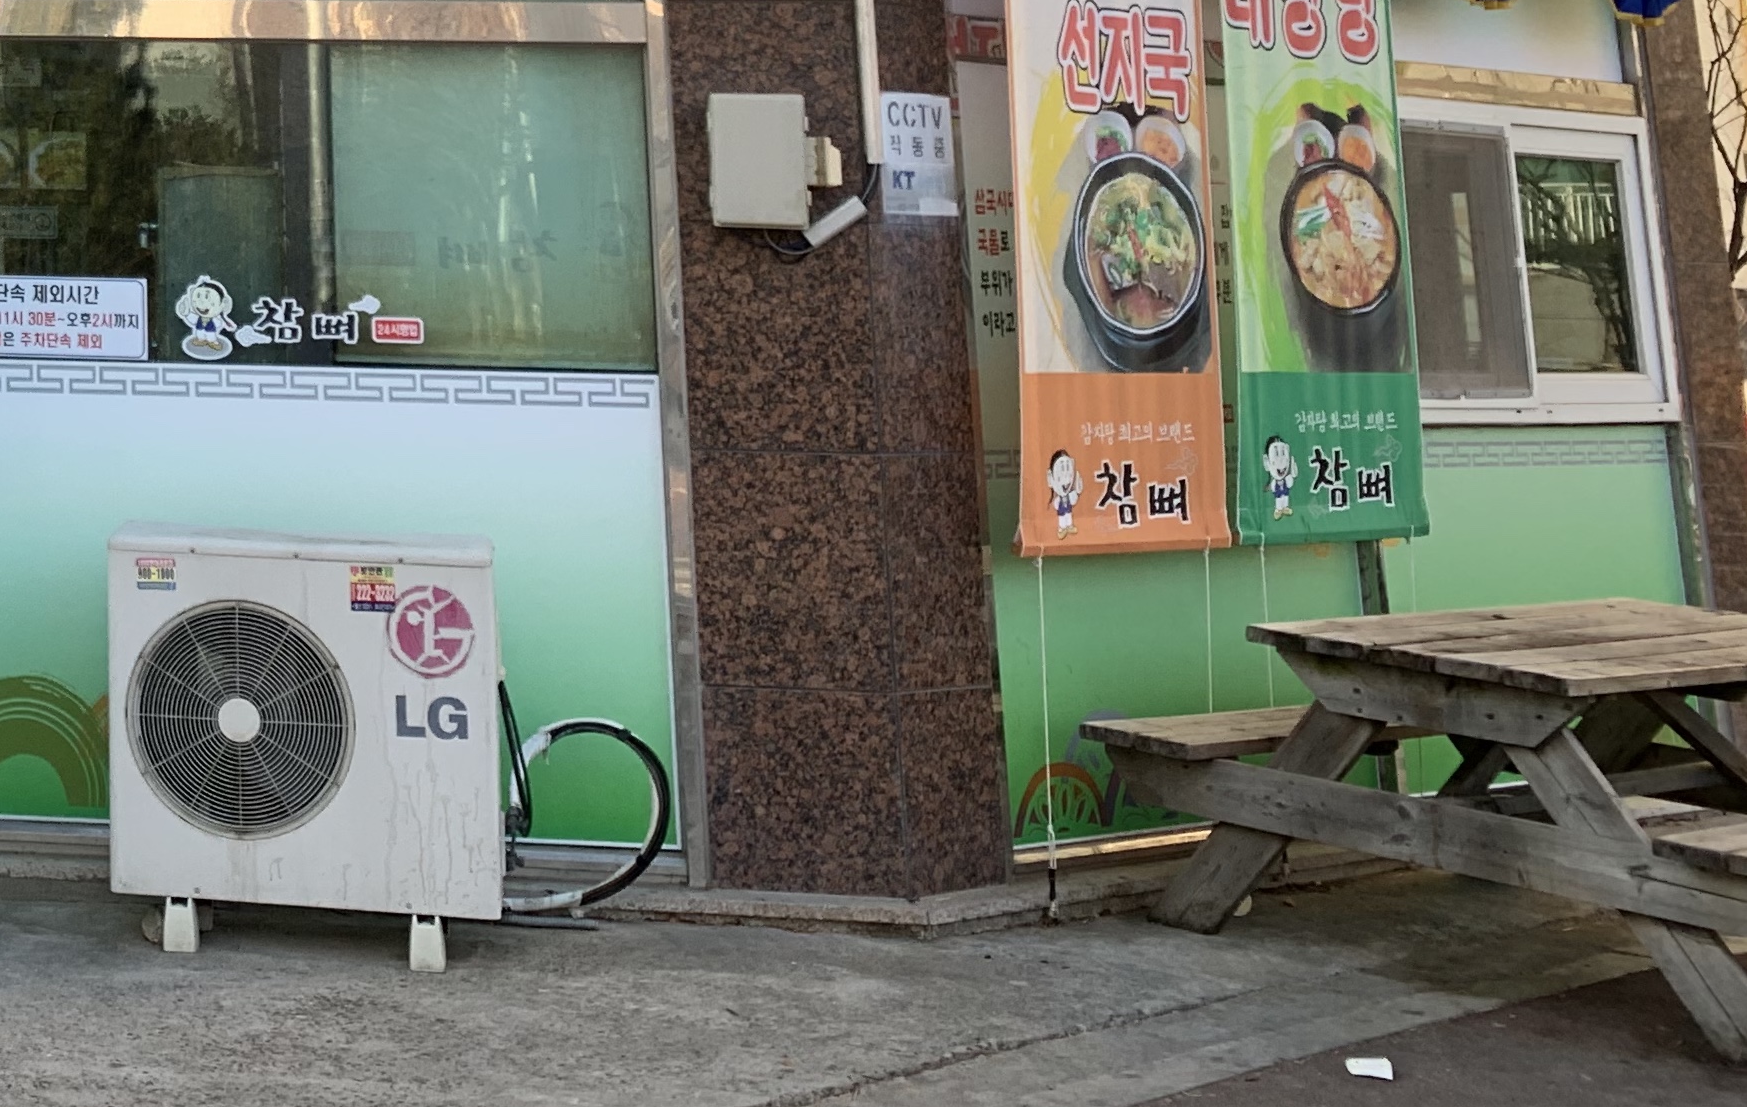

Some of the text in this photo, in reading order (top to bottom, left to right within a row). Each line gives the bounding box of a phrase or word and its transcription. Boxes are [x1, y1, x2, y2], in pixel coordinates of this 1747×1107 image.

[887, 100, 942, 129] CCTV
[892, 170, 915, 190] KT
[32, 283, 100, 305] 제외시간
[251, 296, 359, 344] 참뼈
[21, 331, 71, 349] 주차단속
[77, 333, 103, 349] 제외
[1081, 421, 1115, 445] 감자탕
[1156, 420, 1195, 444] 브랜드
[1295, 410, 1327, 433] 감자탕
[1364, 409, 1399, 432] 브랜드
[1308, 445, 1395, 512] 참뼈
[1094, 459, 1192, 529] 참뼈
[395, 694, 470, 741] LG
